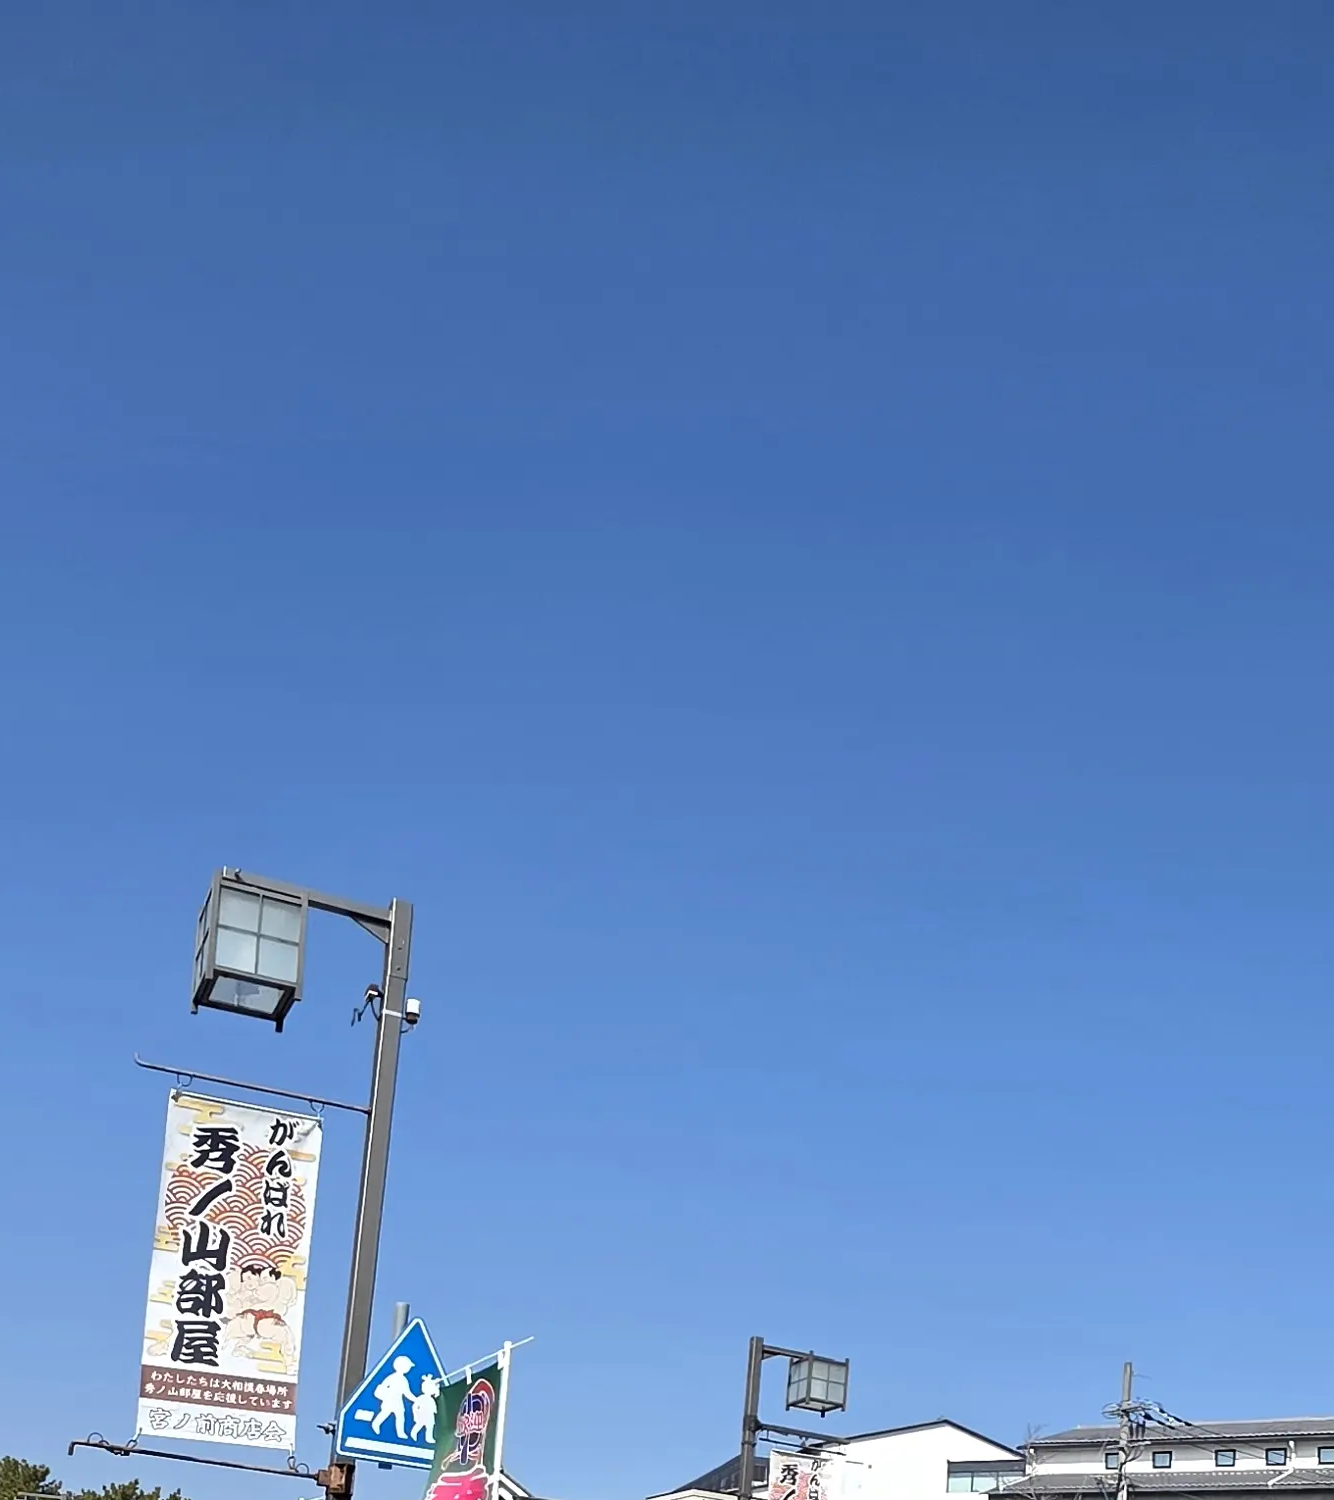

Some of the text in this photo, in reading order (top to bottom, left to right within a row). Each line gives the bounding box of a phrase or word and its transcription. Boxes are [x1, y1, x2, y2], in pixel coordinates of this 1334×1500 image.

[261, 1118, 299, 1238] がんばれ
[171, 1127, 240, 1366] 秀ノ山部屋
[144, 1383, 292, 1410] 秀ノ山部屋を応援しています
[149, 1407, 287, 1443] 宮ノ前商店会
